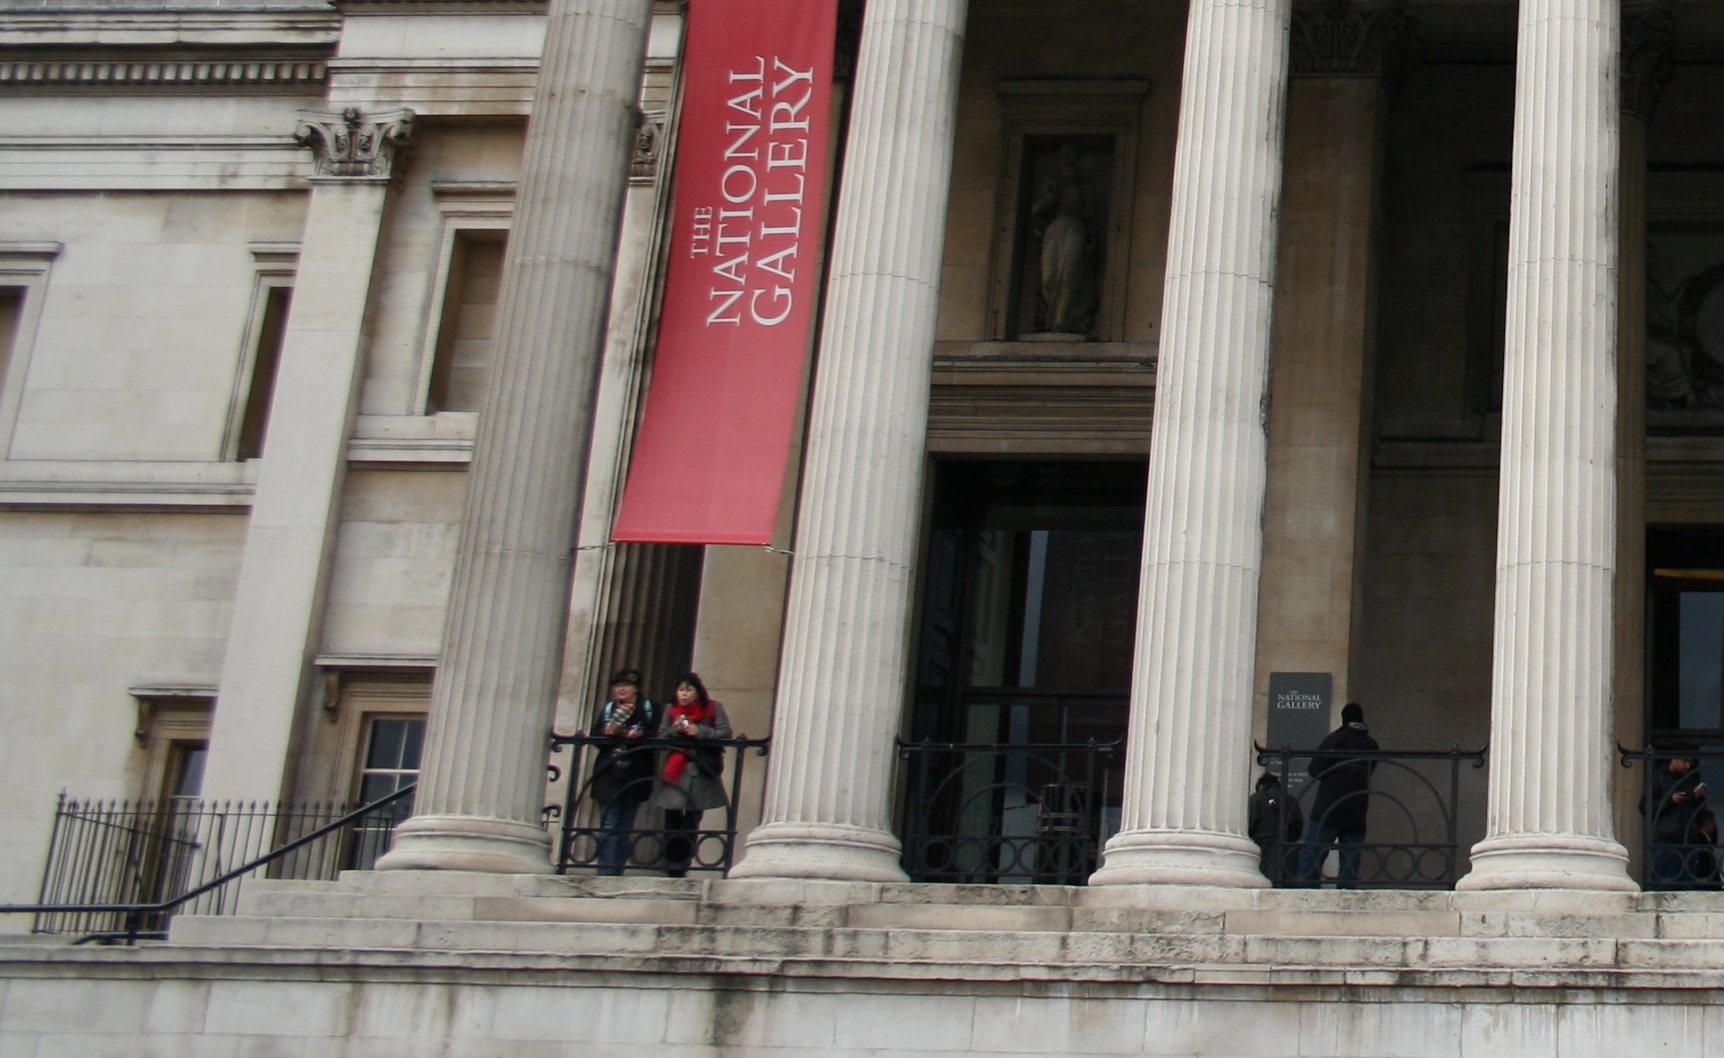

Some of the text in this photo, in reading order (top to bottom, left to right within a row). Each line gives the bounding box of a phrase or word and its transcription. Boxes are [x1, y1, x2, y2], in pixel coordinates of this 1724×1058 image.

[691, 206, 713, 259] THE
[706, 55, 765, 327] NATIONAL
[750, 55, 814, 326] GALLERY
[1277, 701, 1322, 709] GALLERY
